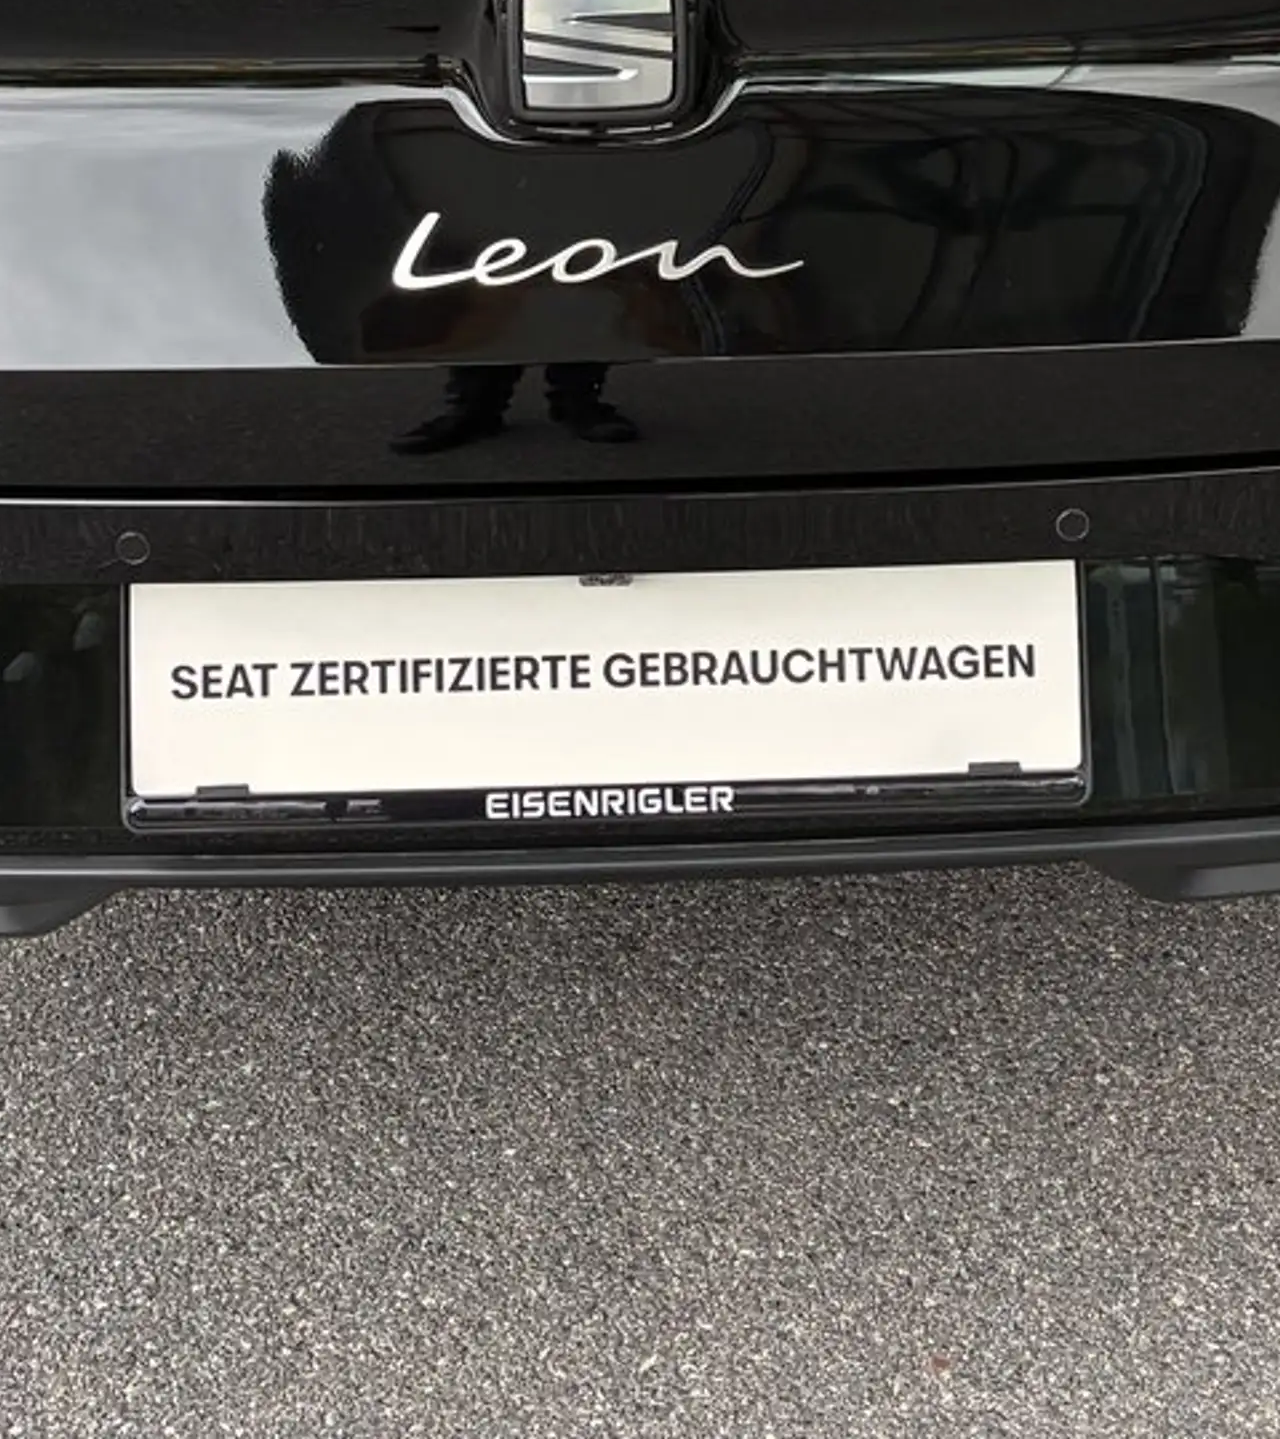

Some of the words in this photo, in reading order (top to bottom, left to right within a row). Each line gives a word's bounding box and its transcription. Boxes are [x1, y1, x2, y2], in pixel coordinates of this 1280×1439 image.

[391, 211, 805, 291] Leon
[172, 663, 278, 700] SEAT
[290, 654, 591, 697] ZERTIFIZIERTE
[603, 644, 1035, 688] GEBRAUCHTWAGEN
[485, 785, 735, 819] EISENRIGLER
